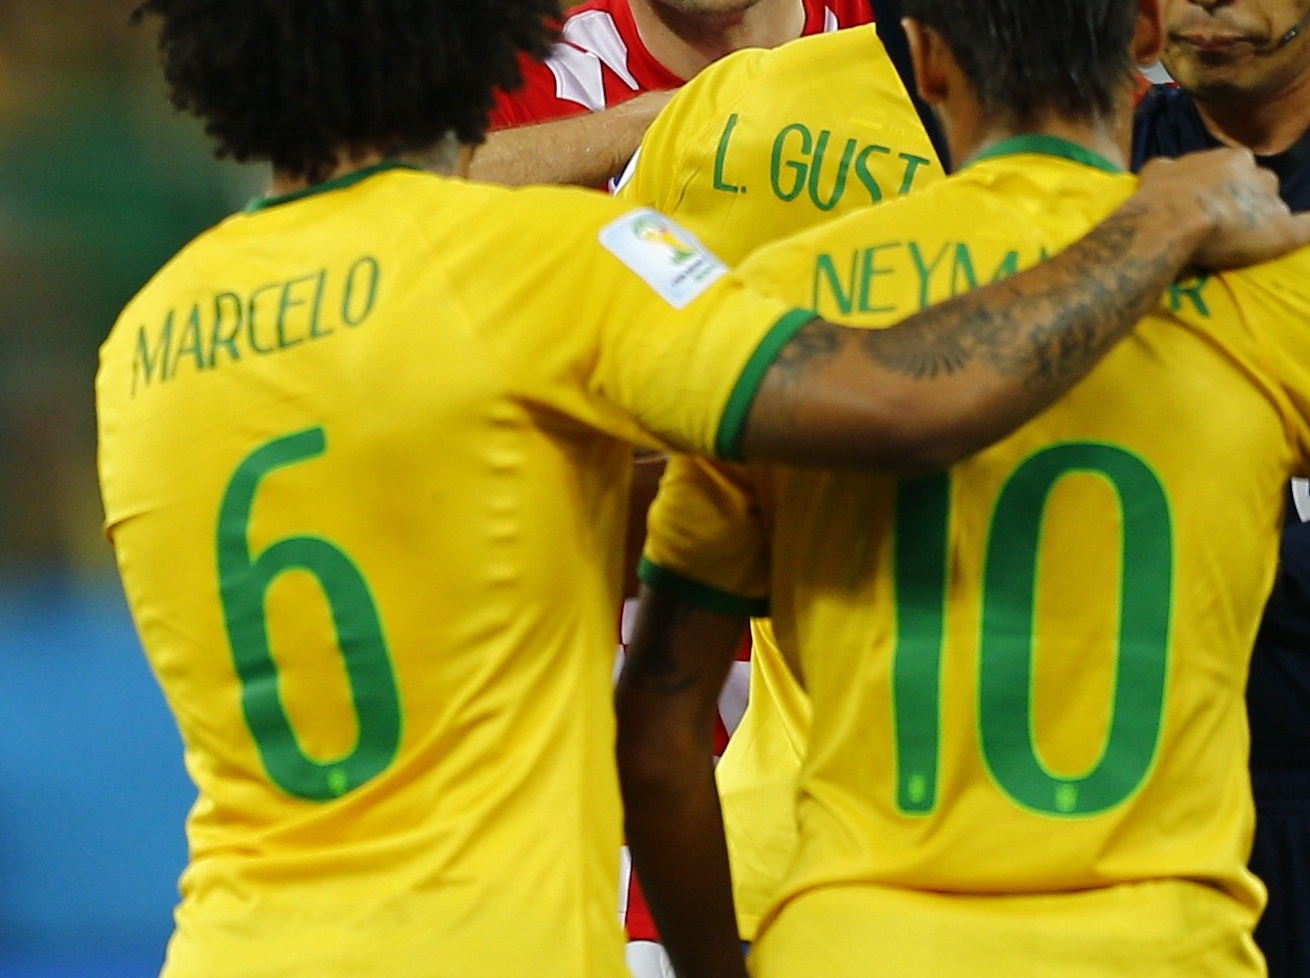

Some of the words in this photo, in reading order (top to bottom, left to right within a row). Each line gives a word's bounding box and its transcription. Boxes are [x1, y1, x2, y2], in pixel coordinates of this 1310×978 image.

[131, 255, 381, 400] MARCELO
[216, 424, 404, 803] 6
[891, 440, 1176, 819] 10
